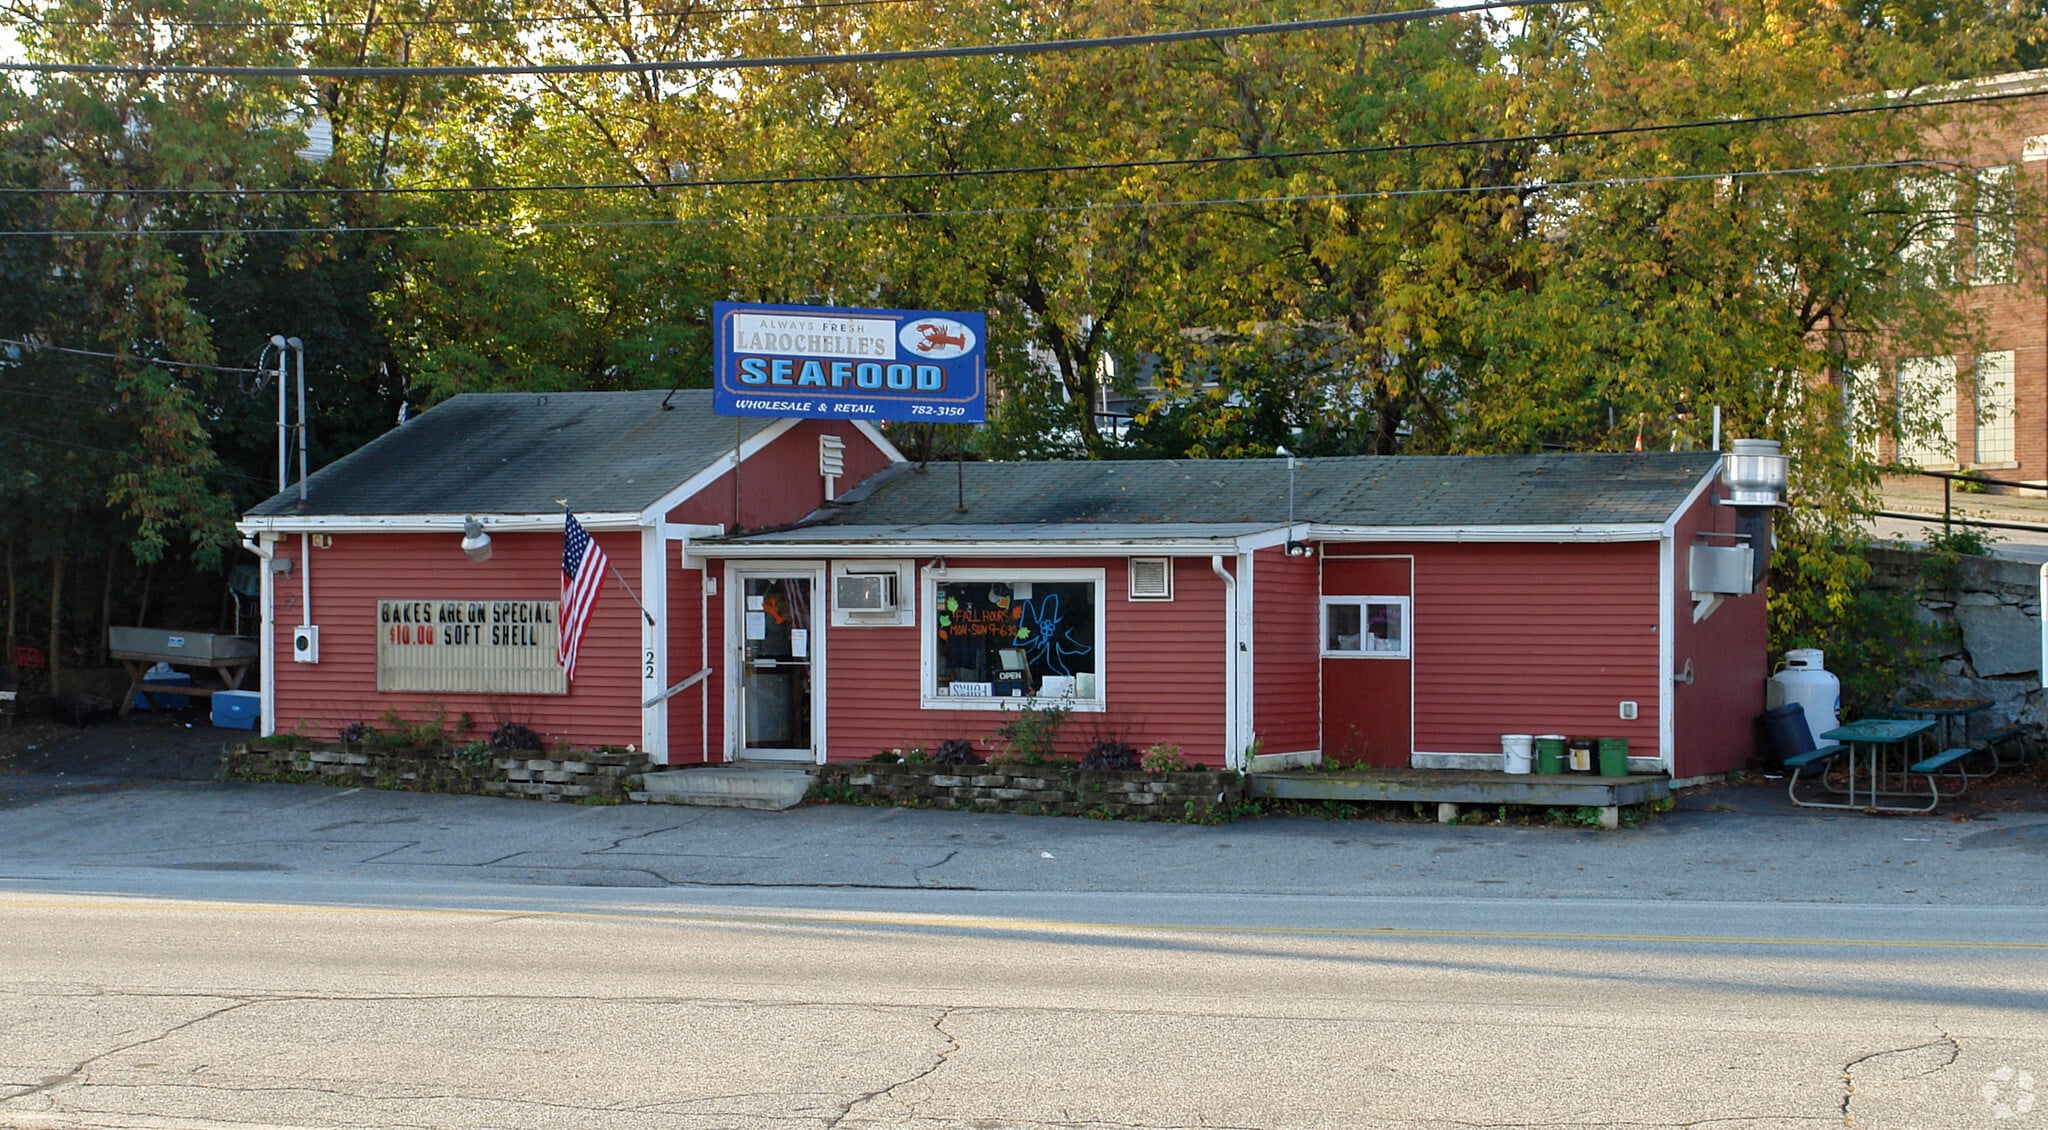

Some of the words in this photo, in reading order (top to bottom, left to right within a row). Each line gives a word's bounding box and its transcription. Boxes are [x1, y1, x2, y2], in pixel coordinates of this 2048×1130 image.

[760, 319, 814, 331] ALWAYS
[822, 322, 865, 334] FRESH
[737, 331, 885, 356] LAROCHELLE'S
[738, 357, 945, 392] SEAFOOD
[735, 400, 810, 412] WHOLESALE
[818, 403, 827, 412] &
[834, 404, 876, 413] RETAIL
[911, 405, 965, 416] 782-3150
[439, 603, 463, 623] ARE
[467, 603, 486, 623] ON
[493, 603, 552, 623] SPECIAL
[389, 625, 433, 645] 0.00
[444, 625, 480, 645] SOFT
[492, 625, 537, 646] SHELL
[1000, 672, 1021, 680] OPEN
